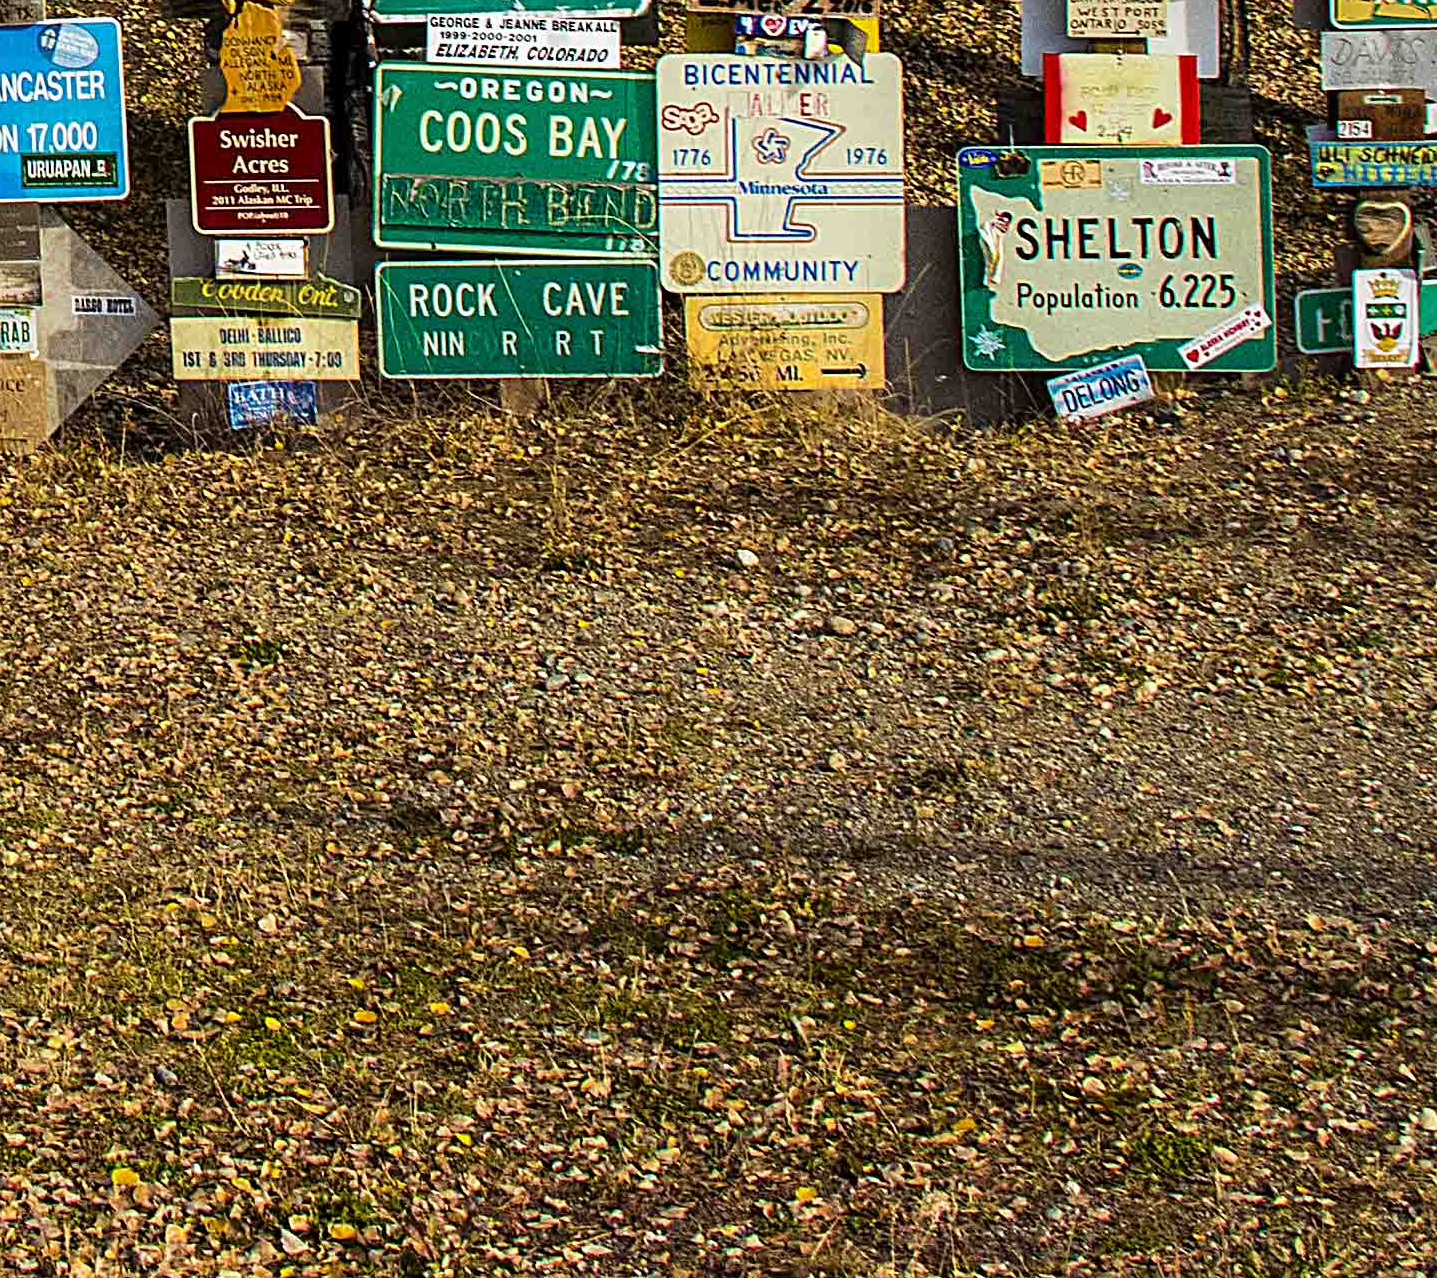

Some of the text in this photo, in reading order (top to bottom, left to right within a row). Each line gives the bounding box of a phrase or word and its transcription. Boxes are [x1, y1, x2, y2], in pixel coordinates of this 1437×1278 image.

[684, 63, 874, 86] BICENTENNIAL
[220, 130, 299, 150] Swisher
[420, 110, 626, 159] COOS BAY
[233, 154, 289, 174] Acres
[672, 148, 711, 166] 1776
[846, 147, 888, 166] 1976
[27, 160, 91, 179] URUAPAN
[739, 181, 829, 197] Minnesota
[1015, 216, 1217, 261] SHELTON
[707, 261, 859, 283] COMMUNITY
[409, 282, 629, 317] ROCK CAVE
